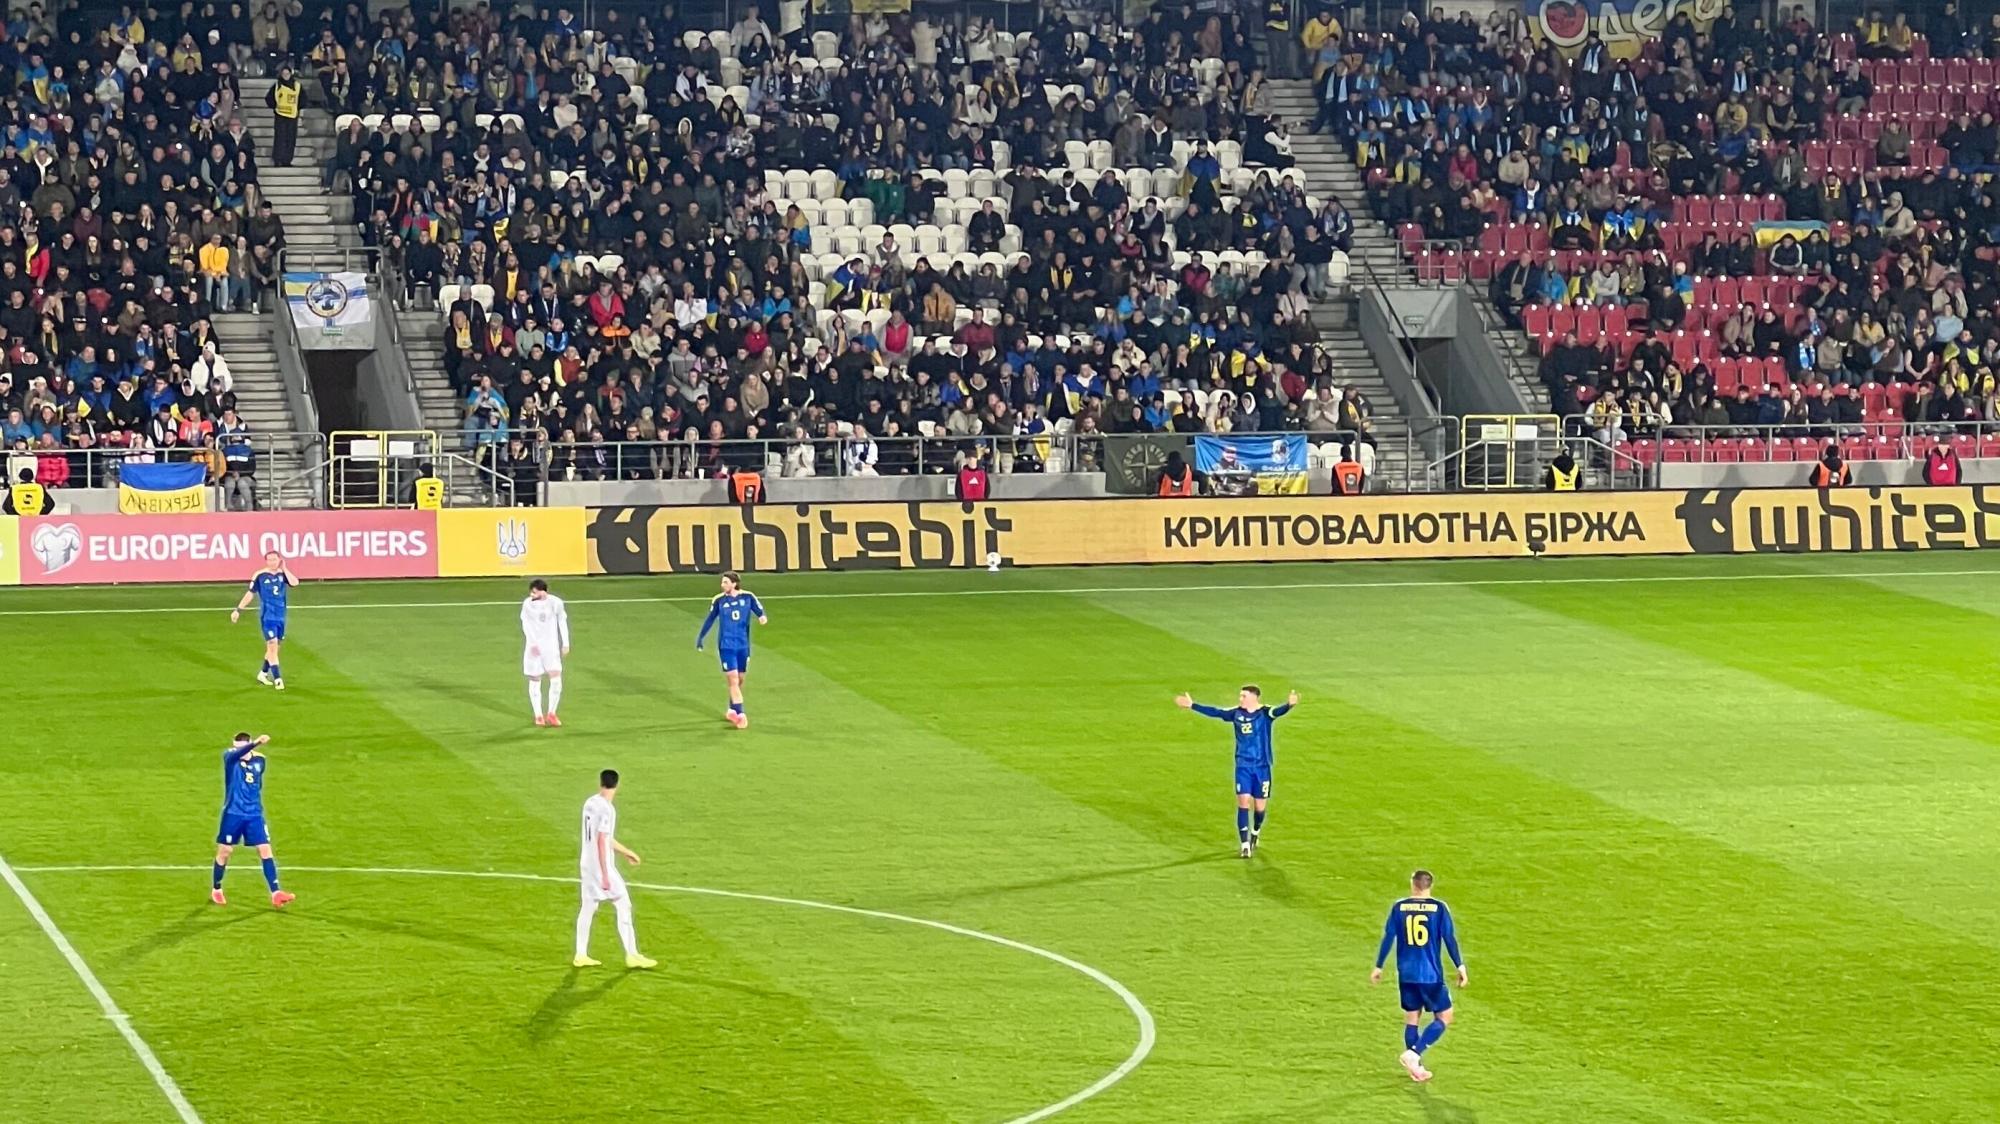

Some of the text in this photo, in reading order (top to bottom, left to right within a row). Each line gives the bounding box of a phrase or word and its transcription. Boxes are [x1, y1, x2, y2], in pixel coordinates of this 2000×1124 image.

[89, 529, 428, 562] EUROPEAN QUALIFIERS
[666, 501, 1014, 574] whitebit
[1164, 511, 1646, 547] КРИПТОВАЛЮТНА БІРЖА
[1406, 914, 1429, 946] 16
